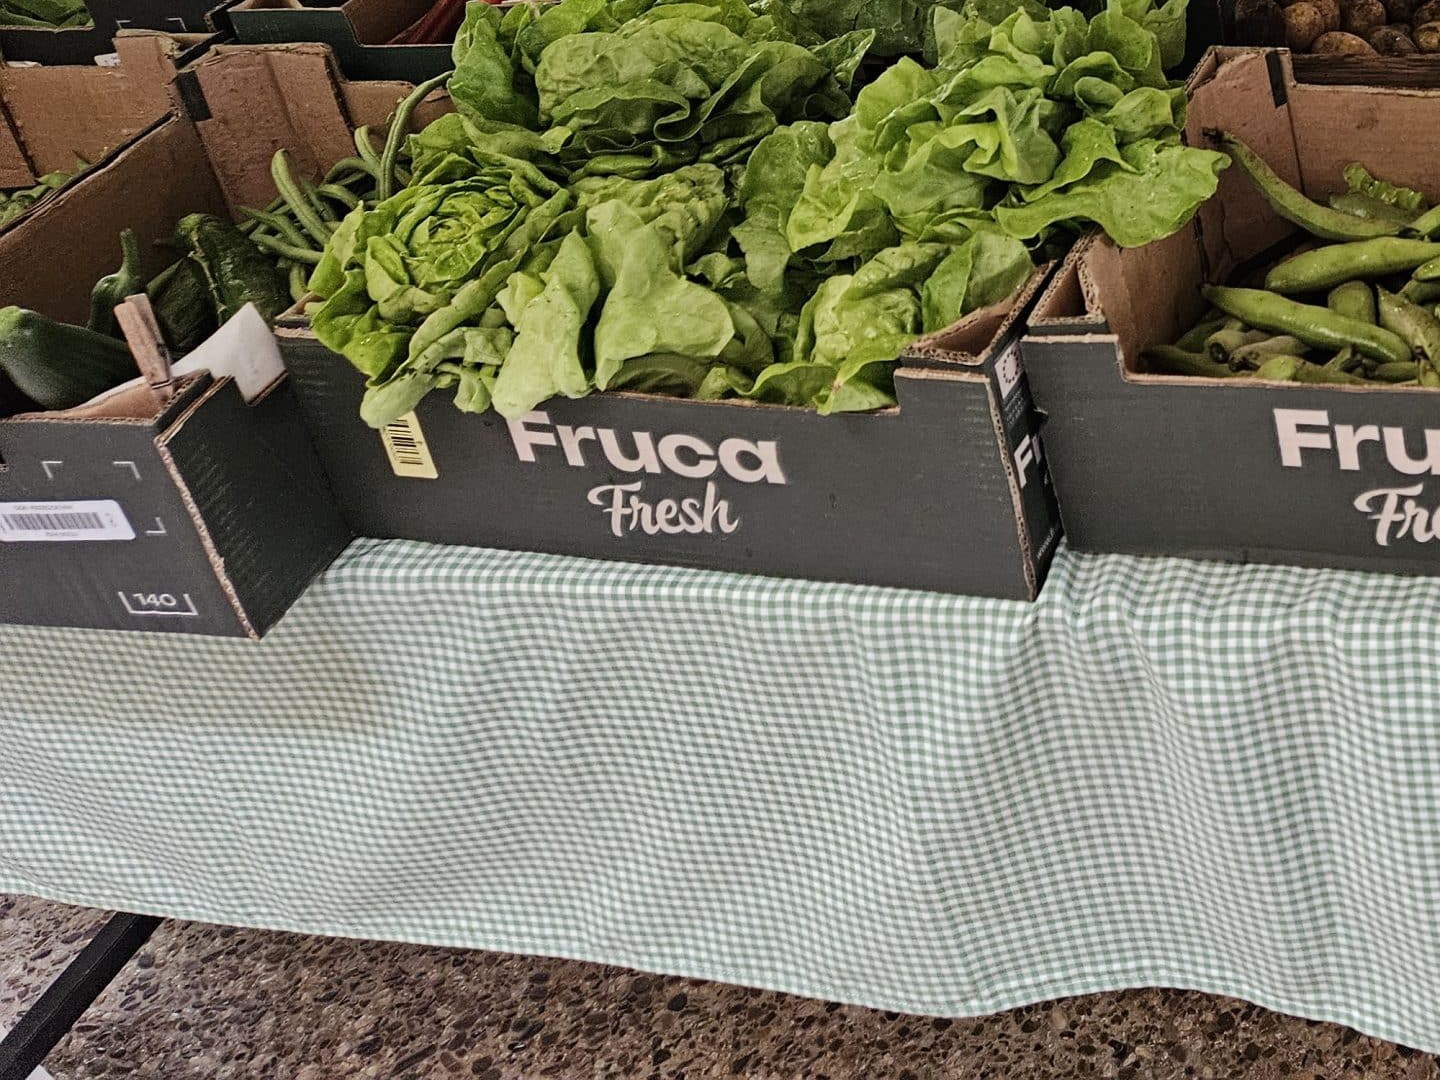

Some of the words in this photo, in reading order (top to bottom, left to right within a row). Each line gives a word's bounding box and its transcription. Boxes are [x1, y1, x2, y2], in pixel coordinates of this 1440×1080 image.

[505, 410, 787, 485] Fruca
[587, 481, 740, 537] Fresh
[133, 593, 177, 607] 140
